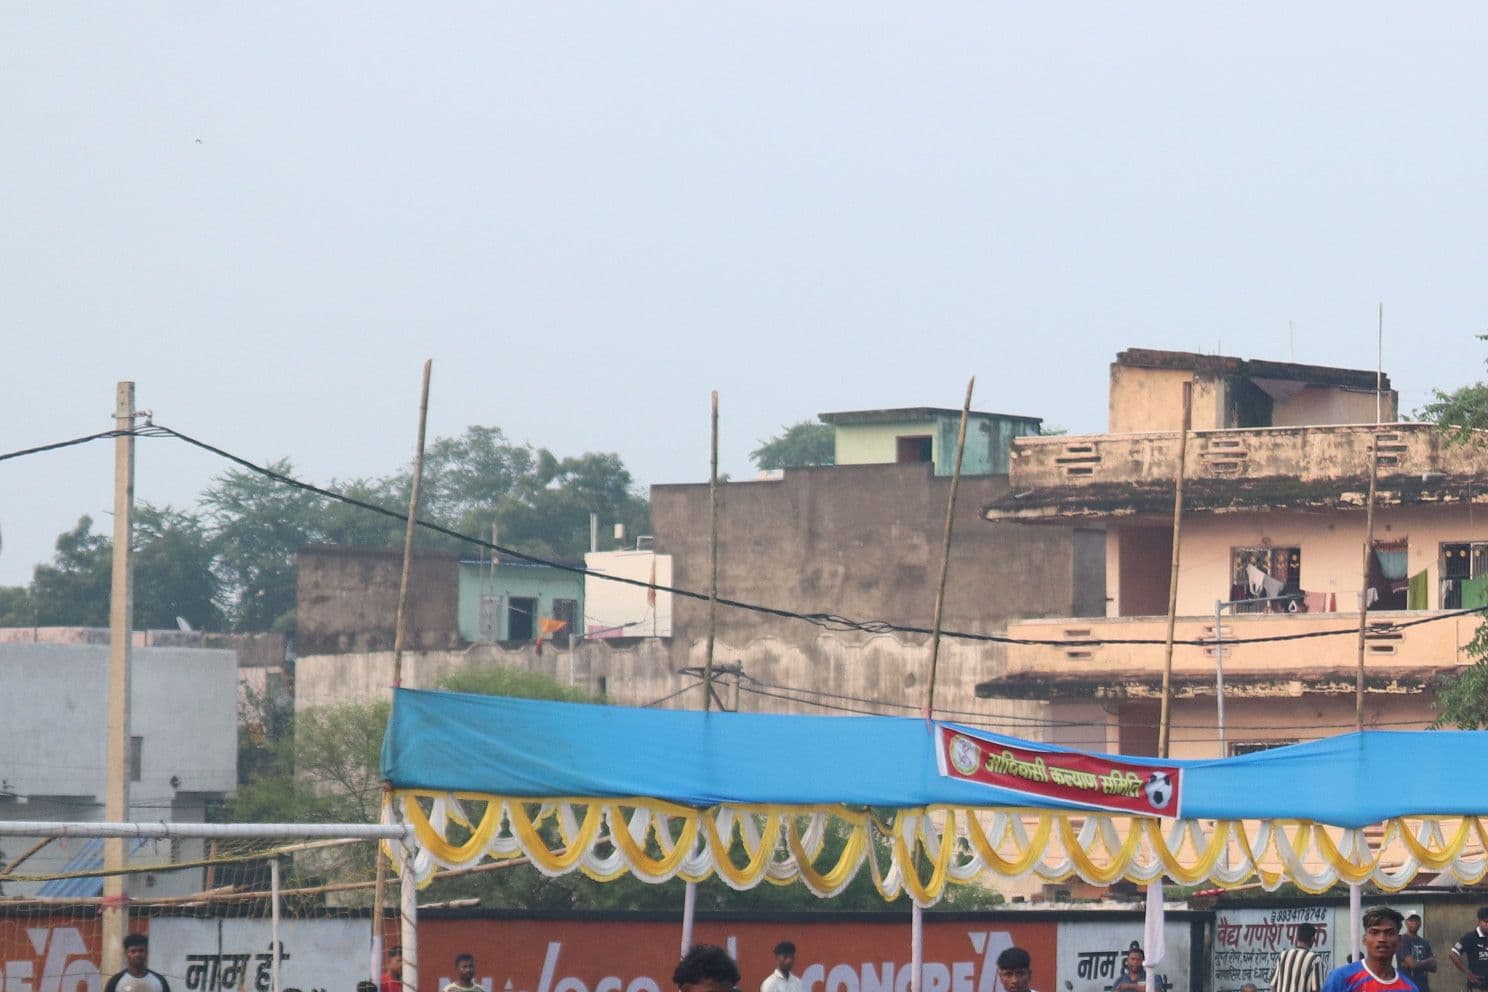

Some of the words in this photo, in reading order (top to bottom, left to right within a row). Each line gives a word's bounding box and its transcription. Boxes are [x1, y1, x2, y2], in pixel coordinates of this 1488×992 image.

[985, 750, 1049, 782] आदिवासी
[1048, 766, 1099, 791] कल्याण
[1098, 769, 1144, 798] समिति
[1243, 917, 1283, 951] गणेश
[1286, 923, 1328, 947] पाक
[185, 953, 251, 992] नाम
[1077, 951, 1118, 980] नाम
